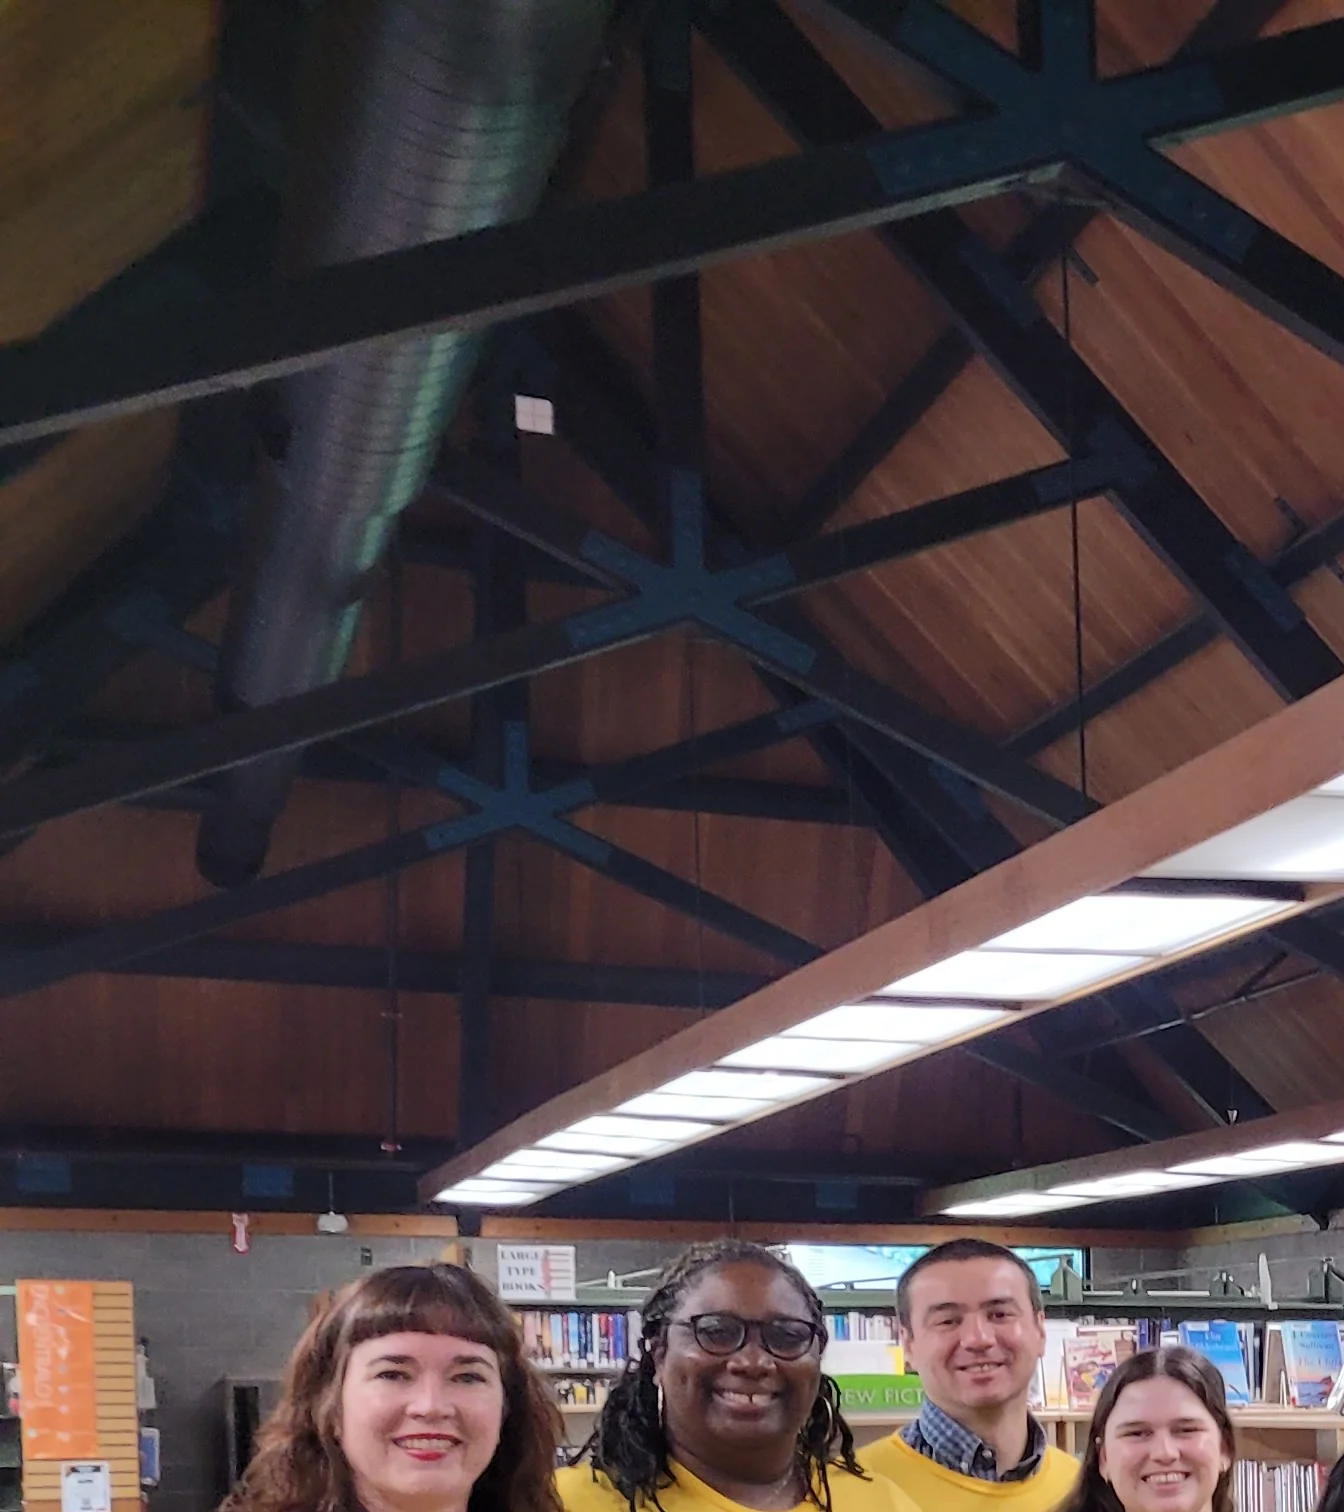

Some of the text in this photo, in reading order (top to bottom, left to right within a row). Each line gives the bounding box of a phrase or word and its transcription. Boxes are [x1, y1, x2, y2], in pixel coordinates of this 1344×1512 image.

[501, 1251, 539, 1260] LARGE
[507, 1266, 536, 1276] TYPE
[840, 1387, 924, 1405] EW FICT
